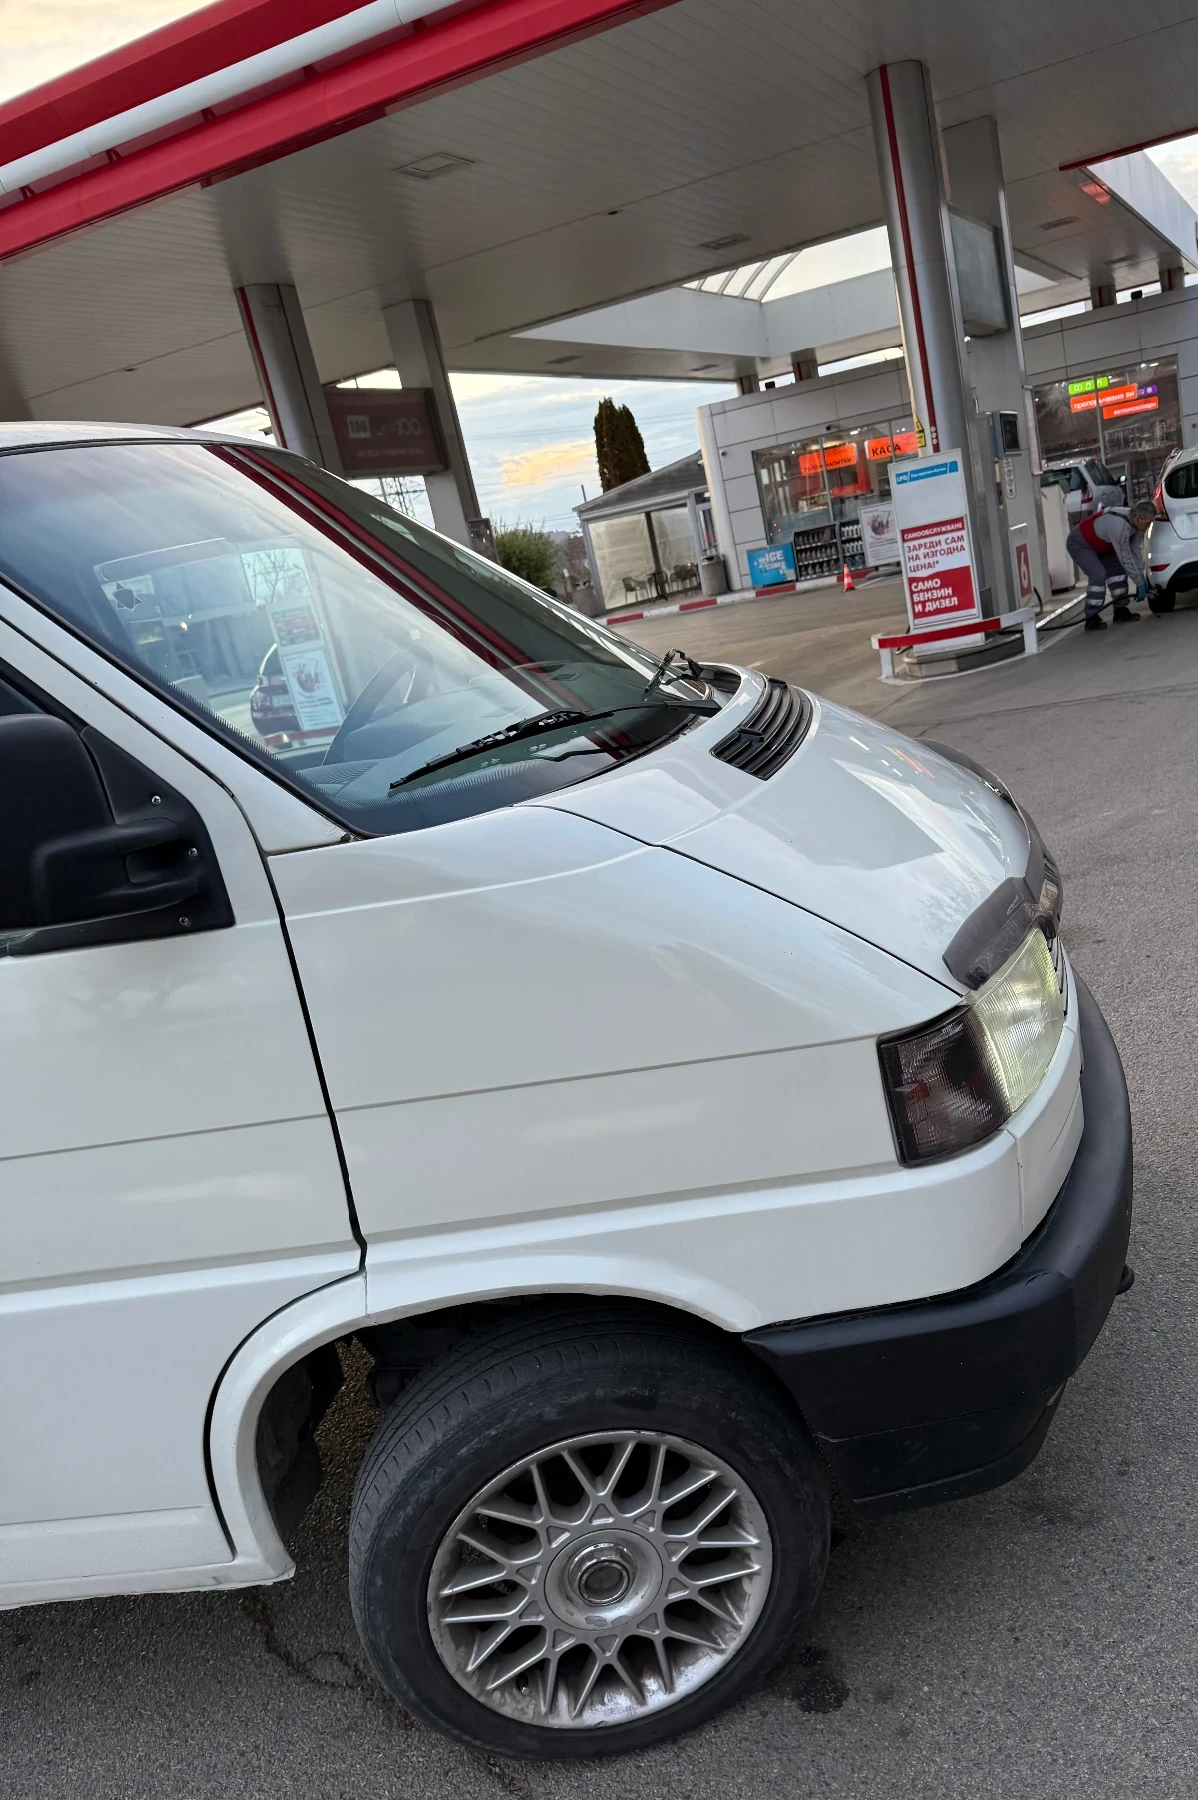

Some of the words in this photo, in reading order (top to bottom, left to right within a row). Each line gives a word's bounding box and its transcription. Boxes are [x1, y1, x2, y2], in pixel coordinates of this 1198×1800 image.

[349, 420, 367, 433] 100
[395, 418, 421, 436] 100
[872, 443, 902, 457] КАСА
[896, 475, 908, 483] LPG
[904, 522, 963, 540] САМООБСЛУЖВАНЕ
[906, 539, 942, 553] ЗАРЕДИ
[945, 535, 965, 545] САМ
[766, 550, 784, 562] ICE
[908, 554, 920, 563] НА
[923, 544, 966, 559] ИЗГОДНА
[1021, 551, 1028, 589] 6
[911, 578, 941, 592] САМО
[913, 586, 953, 602] БЕНЗИН
[914, 603, 923, 613] И
[925, 597, 959, 612] ДИЗЕЛ
